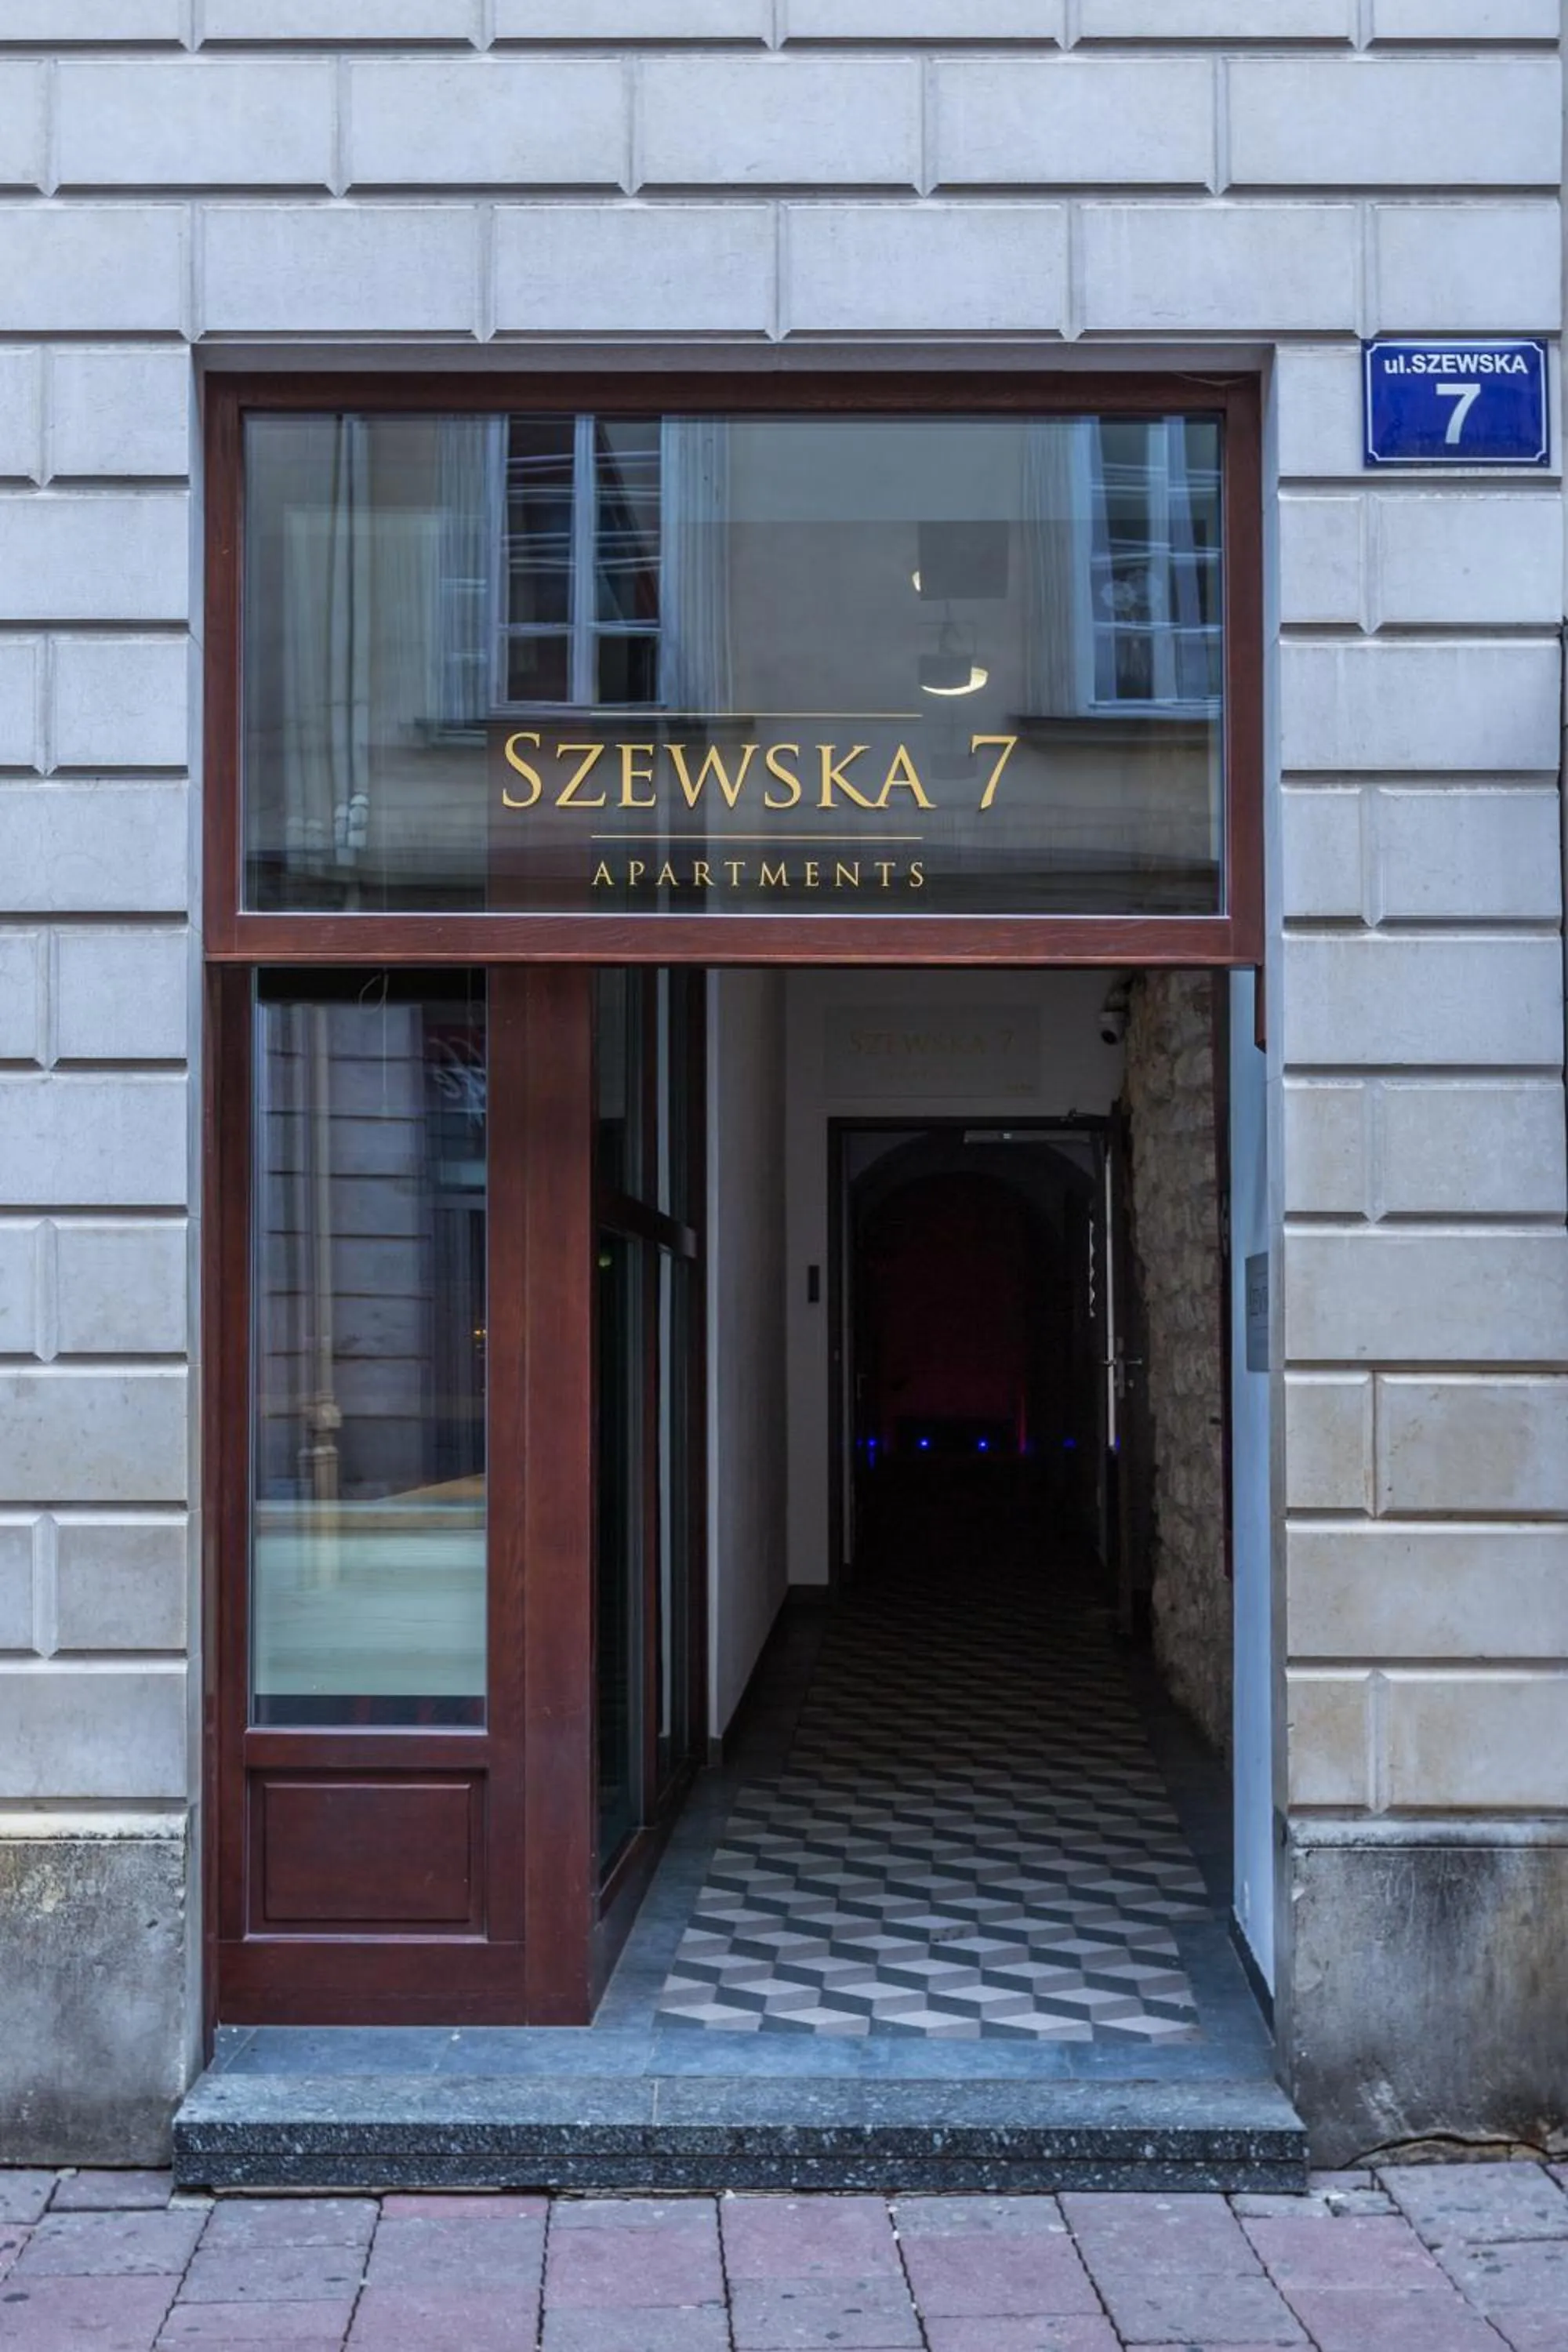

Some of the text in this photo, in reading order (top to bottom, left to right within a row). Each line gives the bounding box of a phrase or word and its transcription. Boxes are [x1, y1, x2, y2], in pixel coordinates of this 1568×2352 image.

[1384, 354, 1528, 374] ul.SZEWSKA
[1436, 383, 1481, 444] 7
[502, 732, 1018, 810] SZEWSKA 7
[591, 861, 925, 887] APARTMENTS
